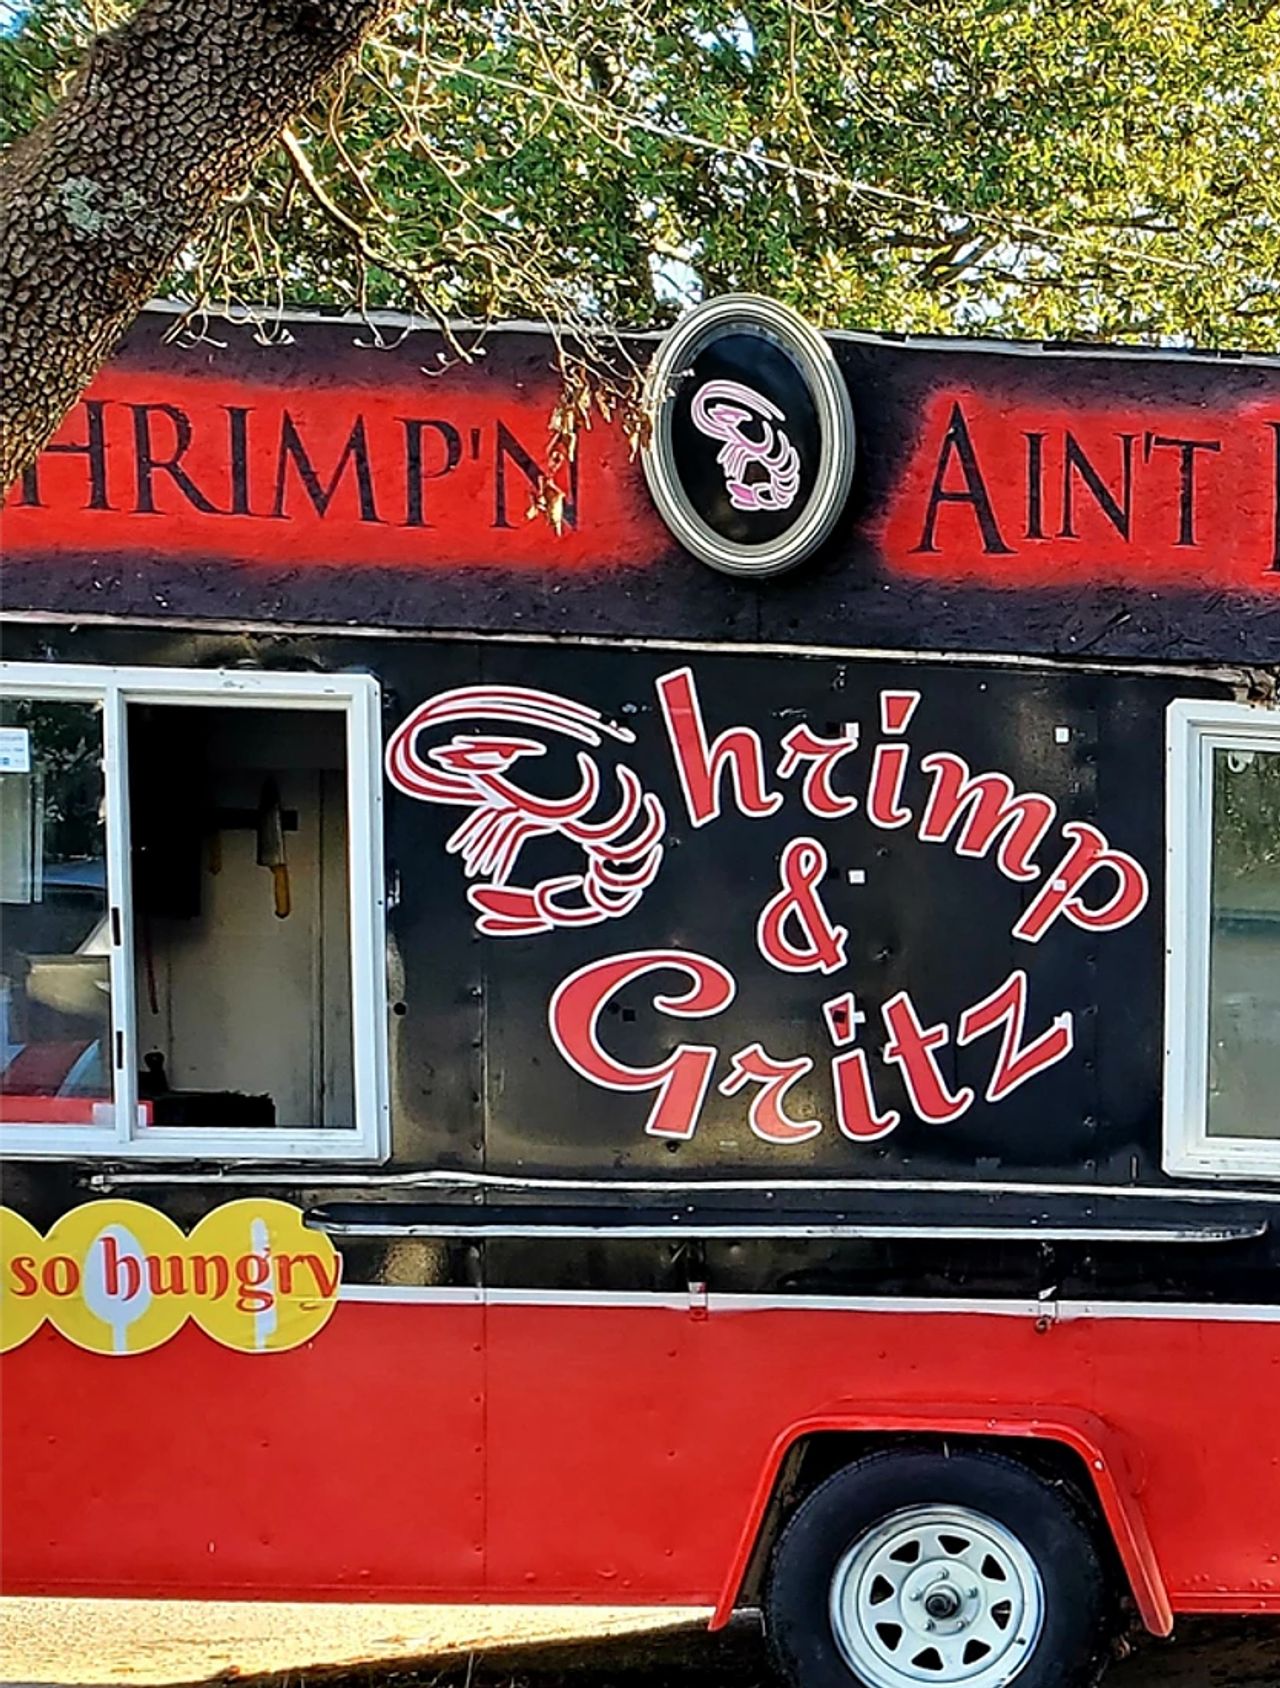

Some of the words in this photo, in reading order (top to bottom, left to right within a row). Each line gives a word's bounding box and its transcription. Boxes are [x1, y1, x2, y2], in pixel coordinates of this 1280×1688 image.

[757, 837, 848, 974] &
[549, 948, 1074, 1140] Gritz
[9, 1254, 82, 1297] so
[98, 1235, 343, 1313] hungry
